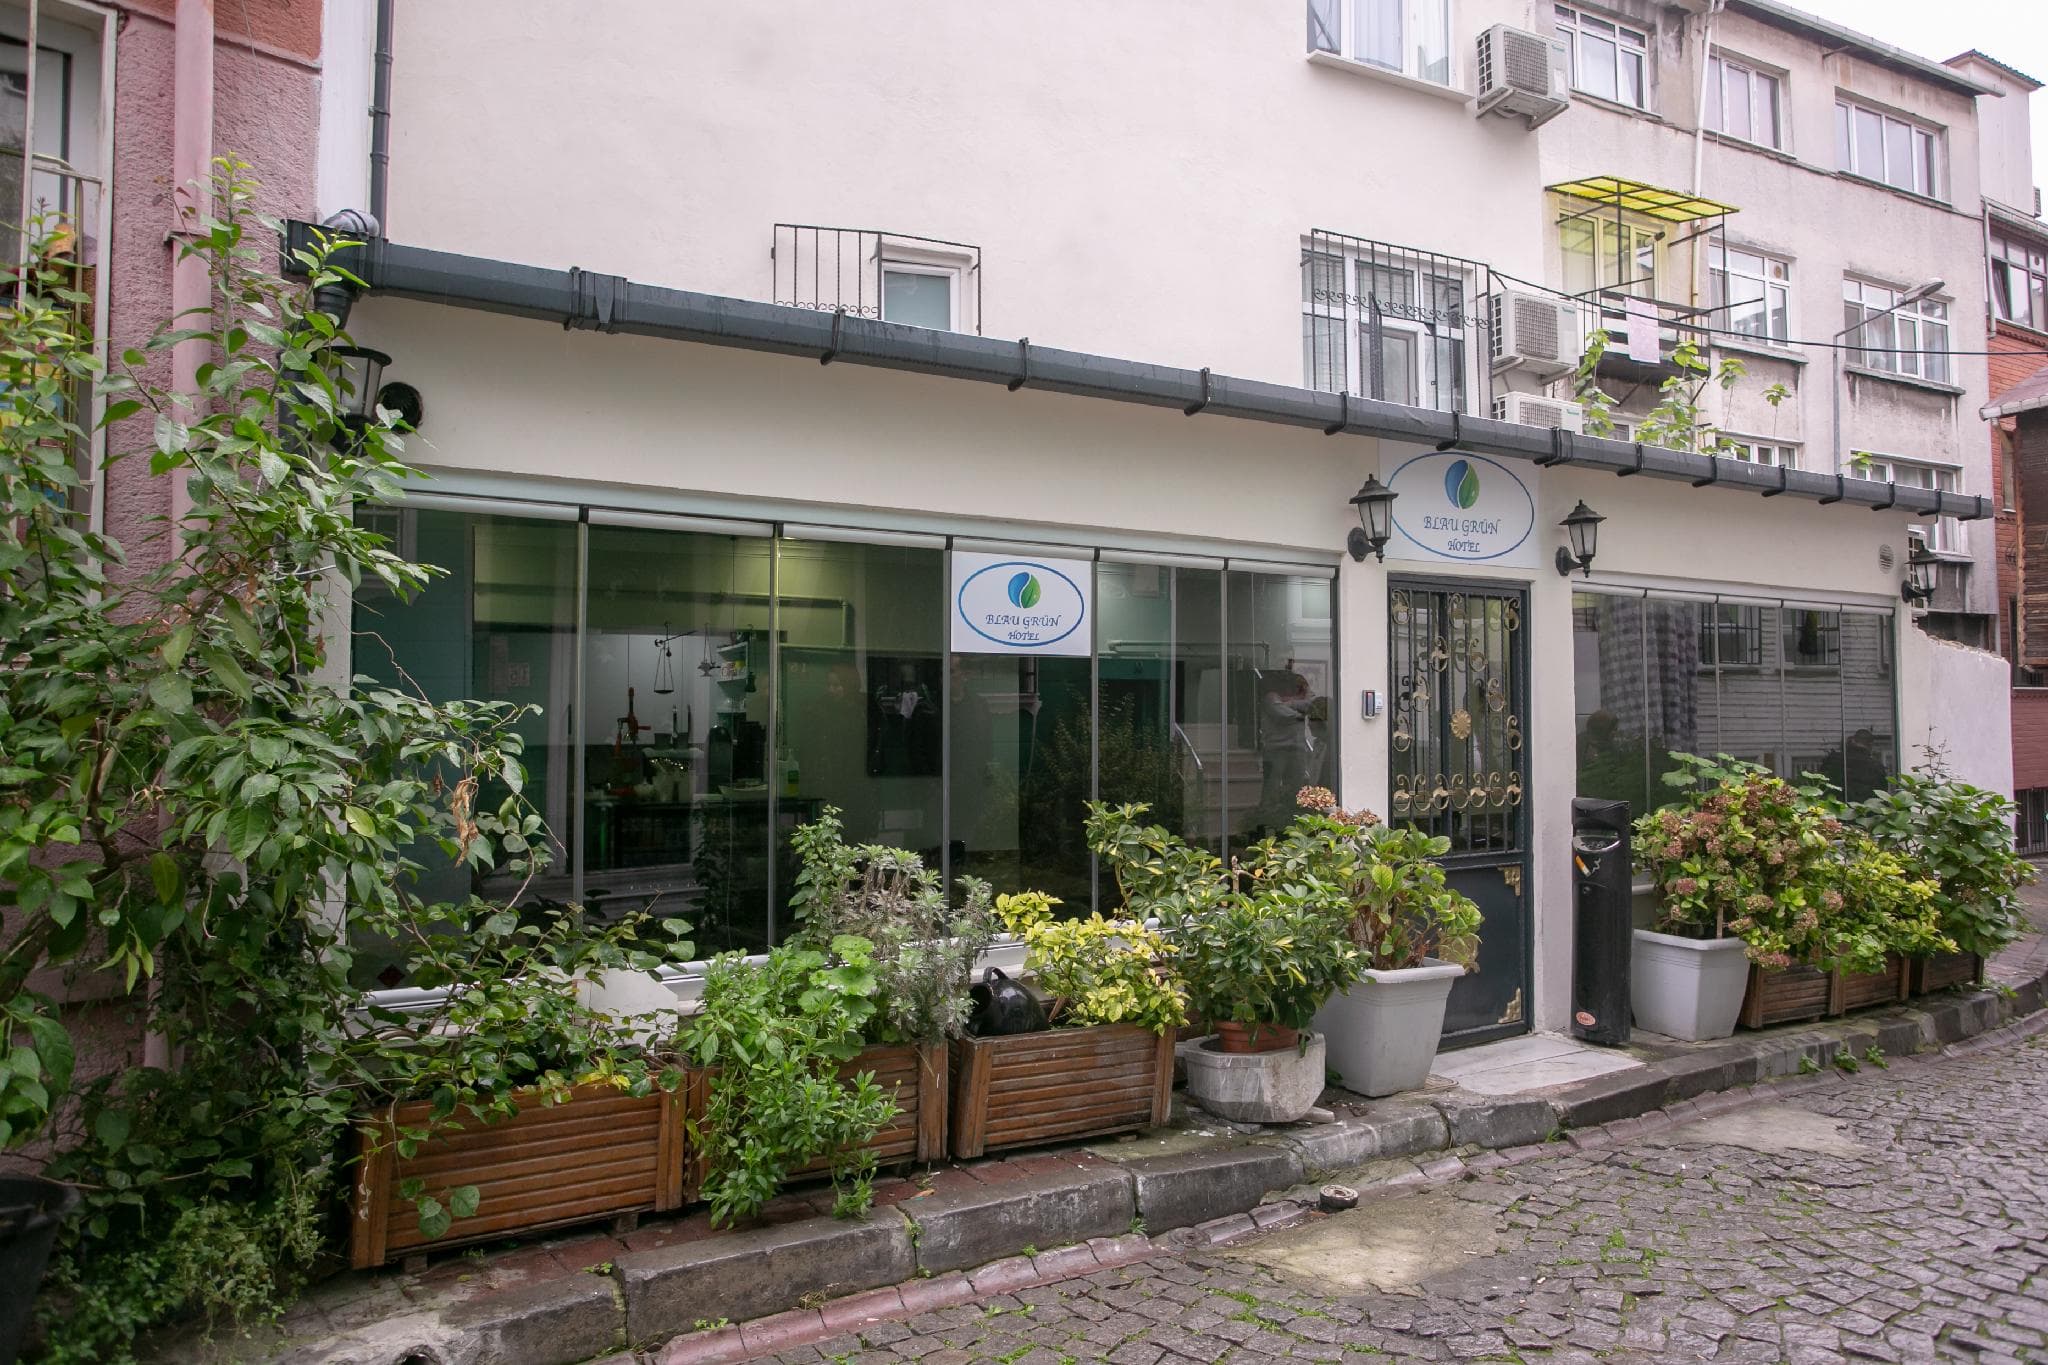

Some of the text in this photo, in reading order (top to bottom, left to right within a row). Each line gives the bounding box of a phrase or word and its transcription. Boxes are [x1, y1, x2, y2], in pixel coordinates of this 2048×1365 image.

[1424, 515, 1459, 531] BLAU
[1448, 539, 1480, 553] HOTEL
[985, 614, 1062, 630] BLAU GRÜN
[1008, 630, 1040, 641] HOTEL
